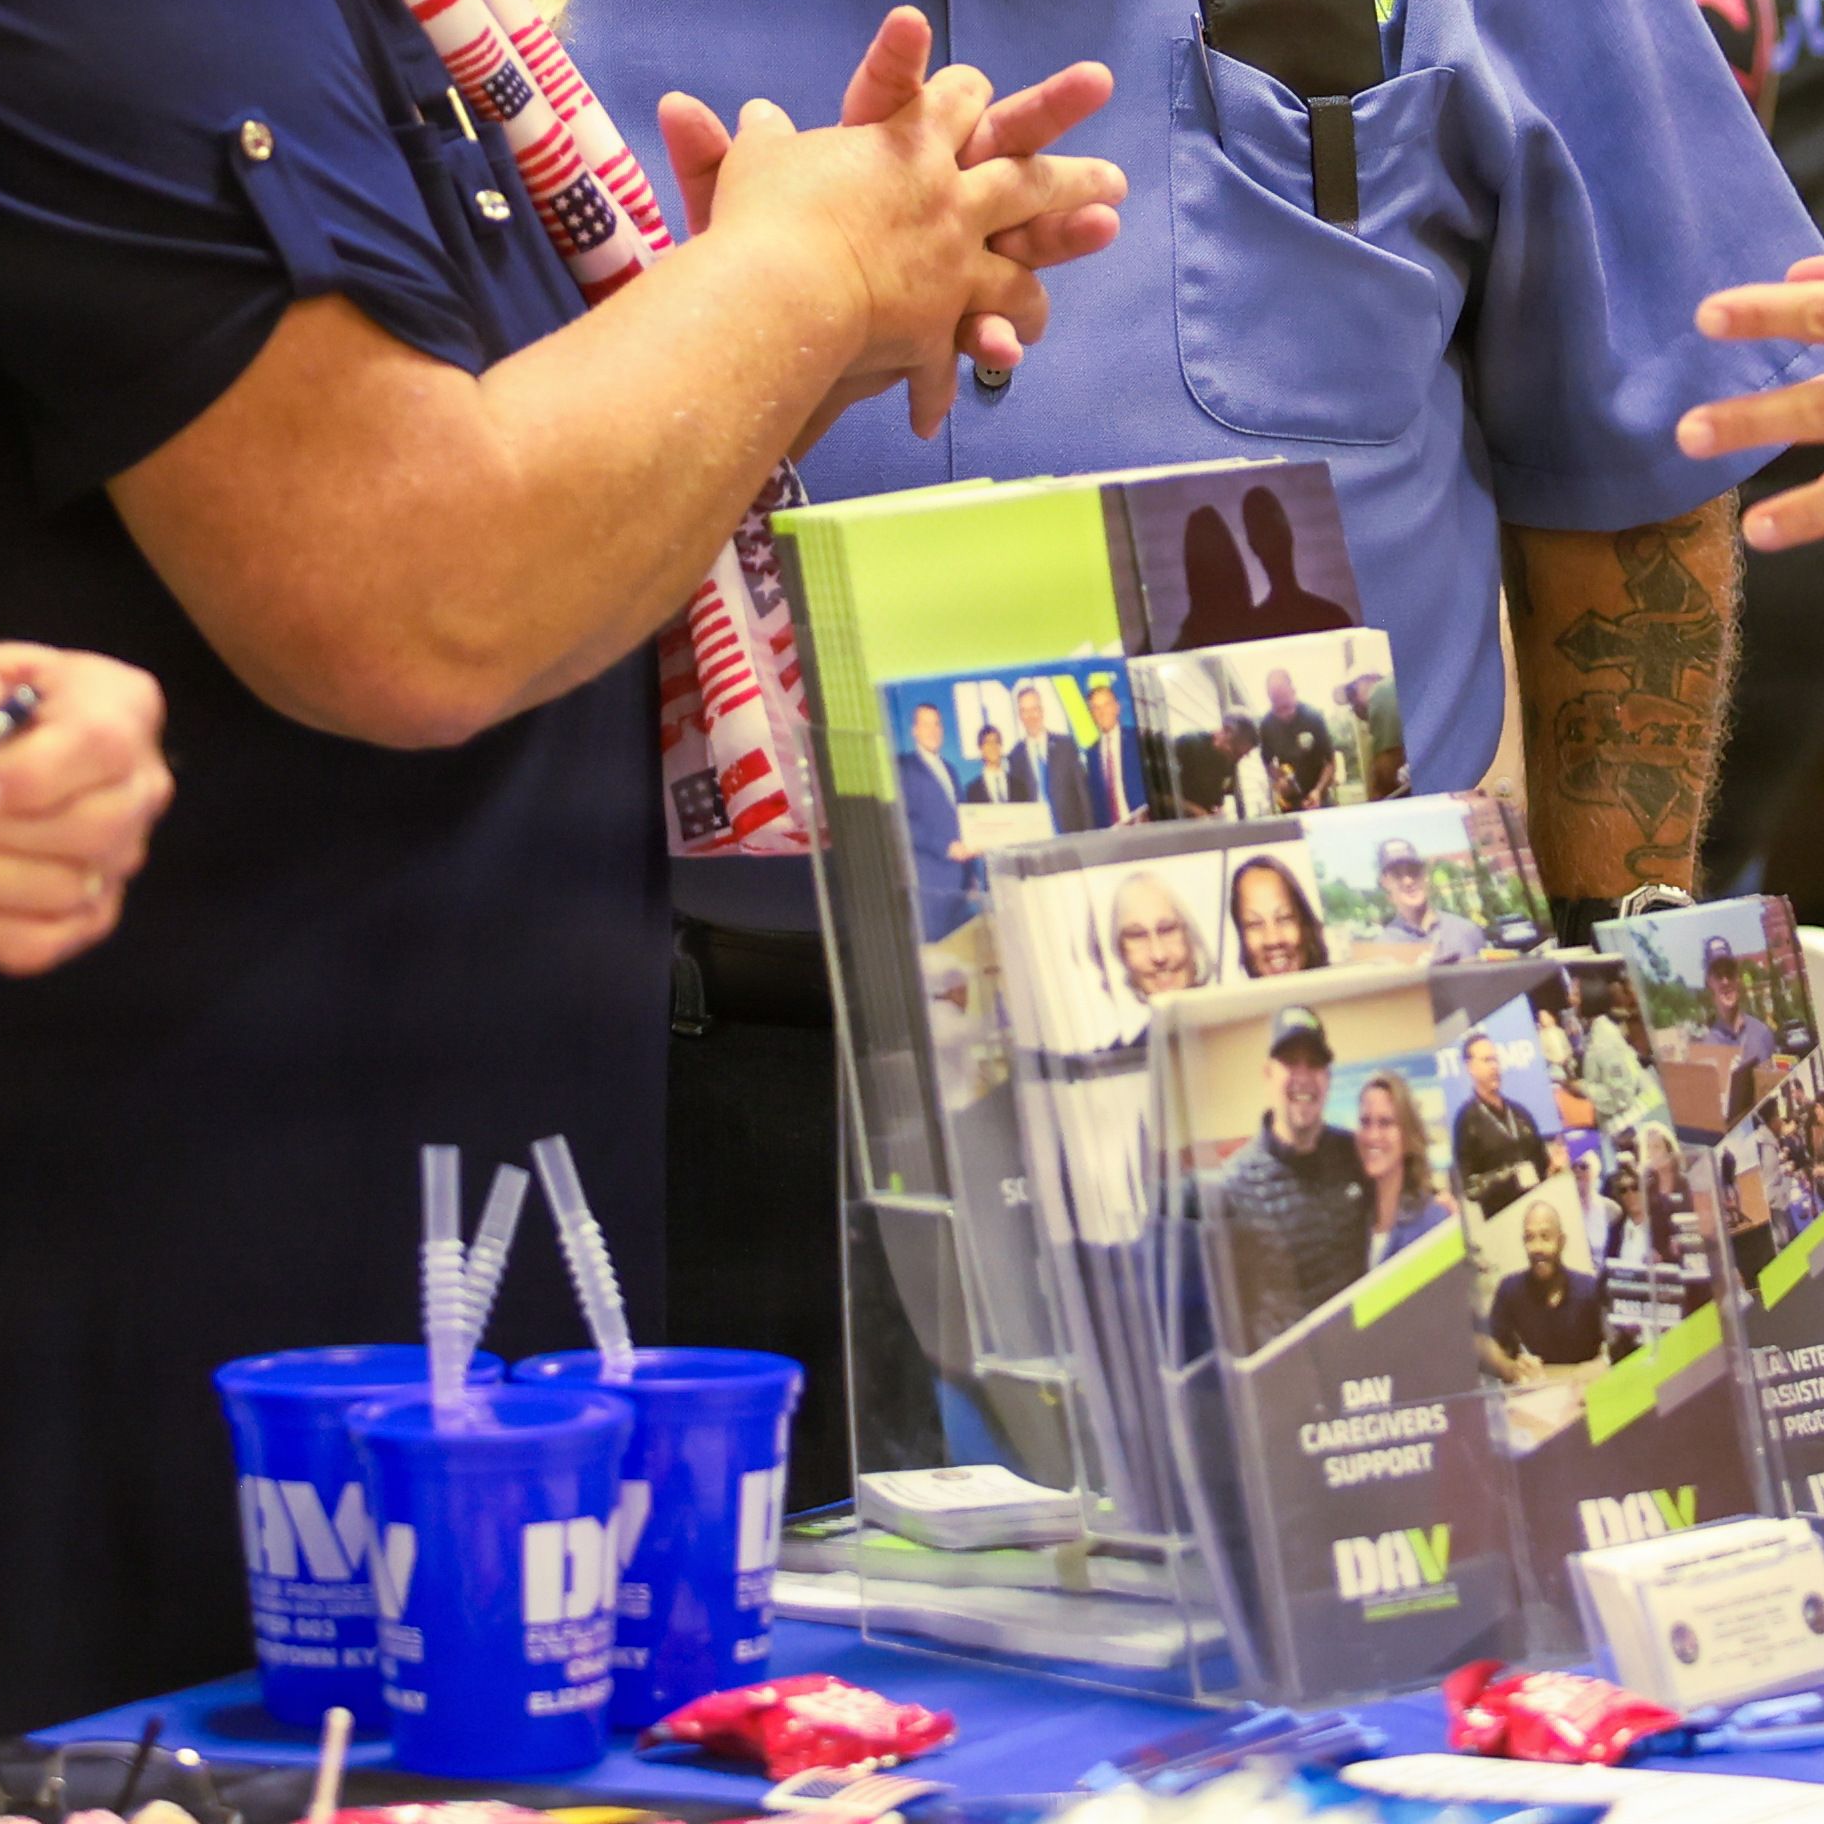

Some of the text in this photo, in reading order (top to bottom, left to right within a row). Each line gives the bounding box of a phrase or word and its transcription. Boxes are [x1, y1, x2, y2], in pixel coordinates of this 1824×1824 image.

[1340, 1374, 1394, 1412] DAV
[1298, 1402, 1450, 1457] CAREGIVERS
[1323, 1440, 1435, 1488] SUPPORT
[1577, 1484, 1698, 1551] DAV
[1332, 1522, 1453, 1602] DAV
